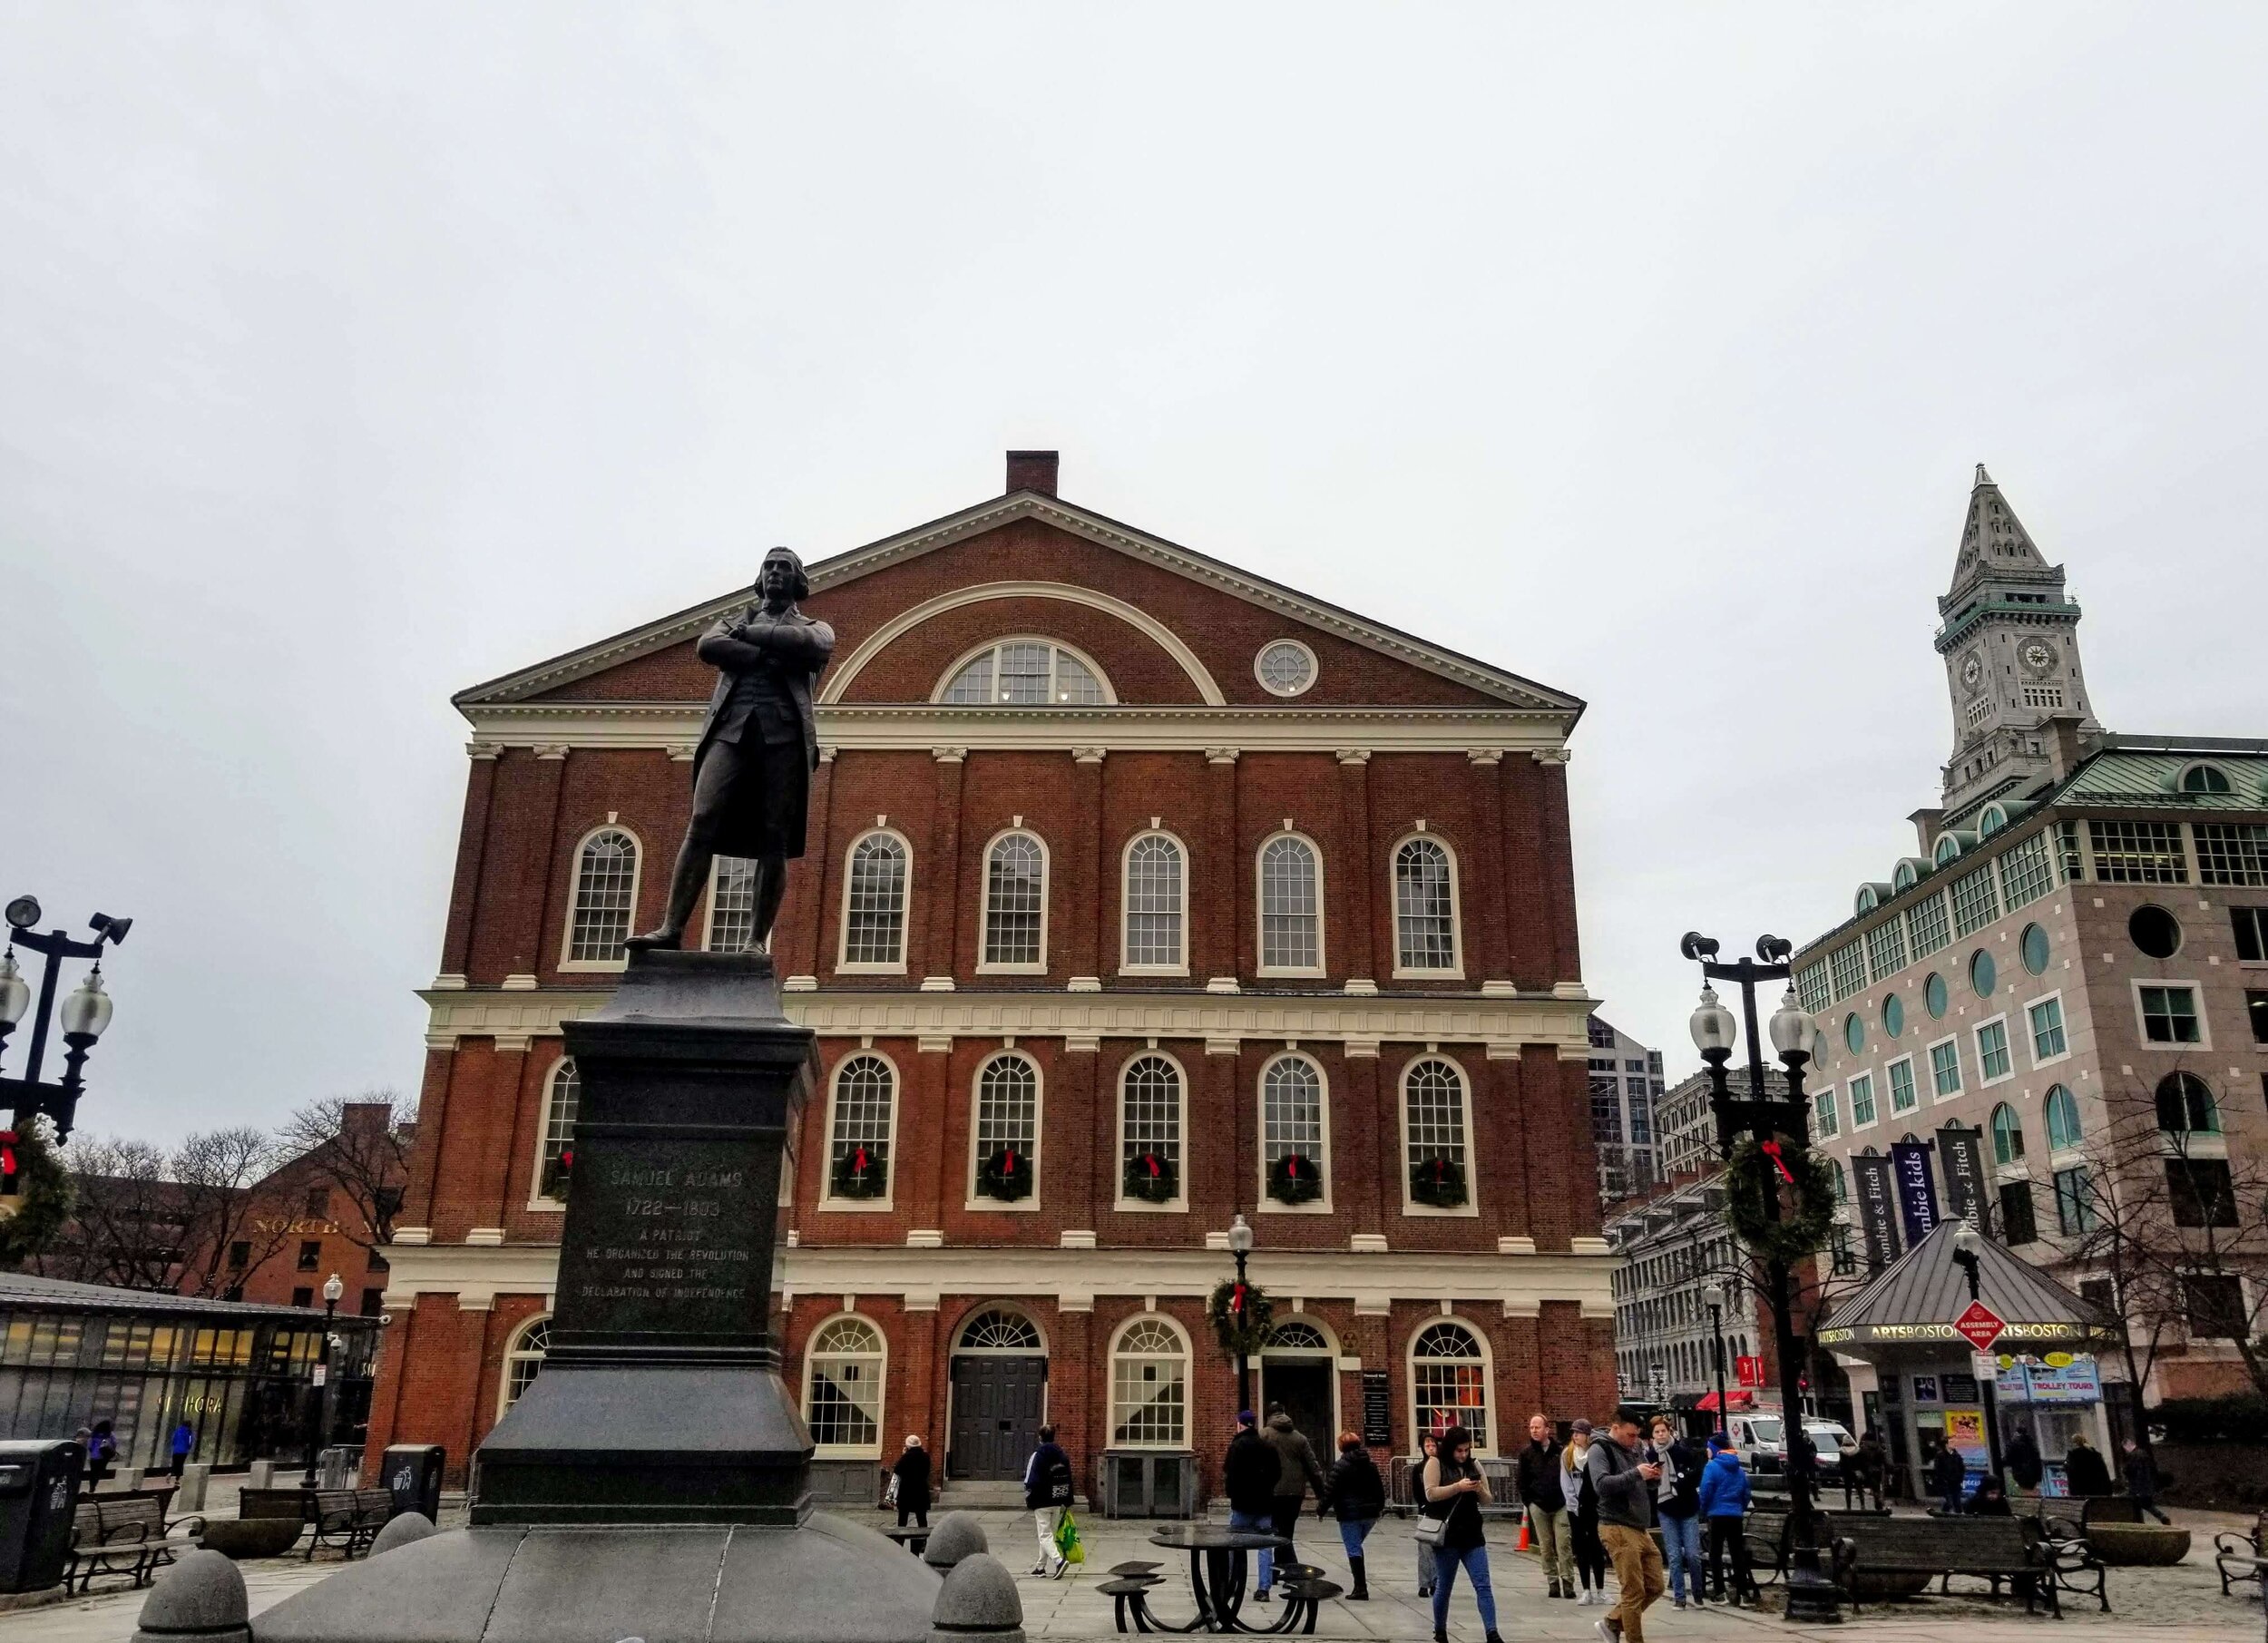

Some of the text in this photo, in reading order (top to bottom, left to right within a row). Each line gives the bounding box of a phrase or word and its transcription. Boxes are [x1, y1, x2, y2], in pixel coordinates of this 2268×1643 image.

[611, 1170, 743, 1188] SAMUEL ADAMS
[1952, 1140, 1980, 1232] Fitch & mbie
[1905, 1151, 1932, 1234] mbie kids
[1865, 1167, 1892, 1266] rombie & Fitch
[639, 1228, 702, 1242] A PATRIOT
[586, 1247, 749, 1262] HE ORGANIZED THE REVOLUTION
[623, 1268, 708, 1280] AND SIGNED THE
[582, 1286, 747, 1299] DECLARATION OF INDEPENDENCE
[1960, 1321, 1999, 1329] ASSEMBLY
[1999, 1324, 2081, 1338] RTSBOSTON
[1970, 1330, 1992, 1338] AREA
